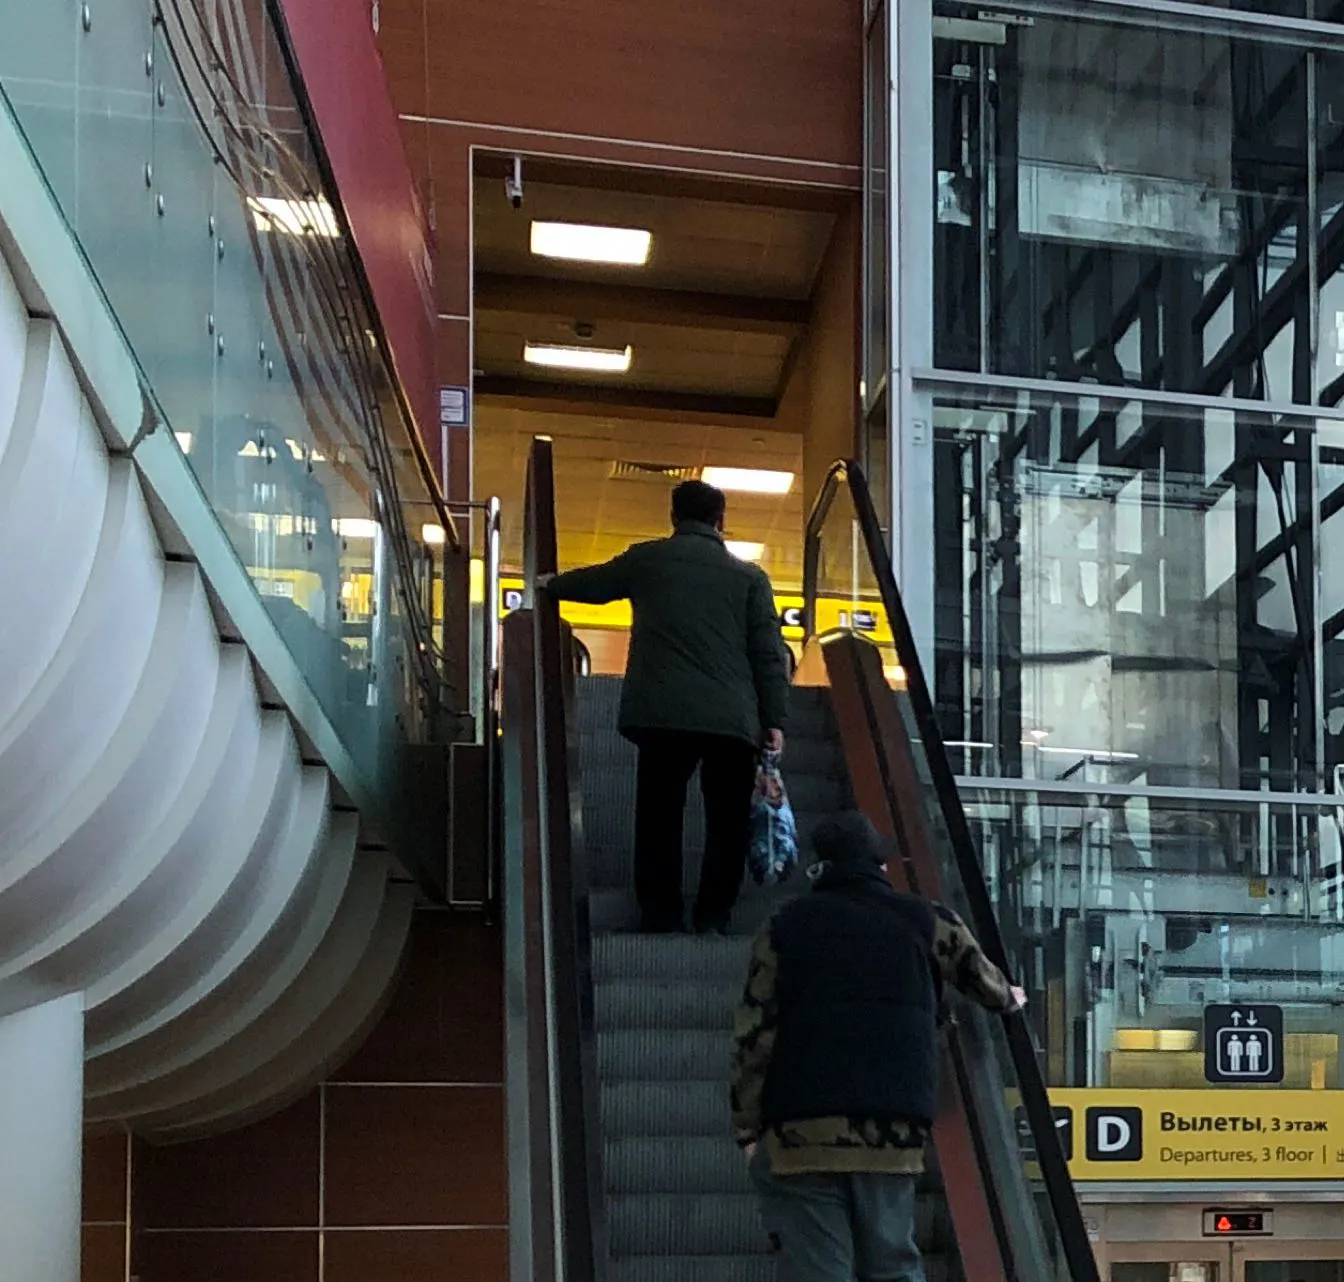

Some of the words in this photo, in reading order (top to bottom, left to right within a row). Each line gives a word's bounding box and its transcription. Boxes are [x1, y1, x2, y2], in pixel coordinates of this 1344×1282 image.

[506, 591, 522, 609] D
[1160, 1112, 1267, 1134] Вылеты,
[1271, 1118, 1281, 1131] 3
[1285, 1119, 1328, 1131] этаж
[1097, 1115, 1131, 1152] D
[1160, 1147, 1258, 1165] Departures,
[1262, 1149, 1272, 1162] 3
[1275, 1147, 1314, 1162] floor
